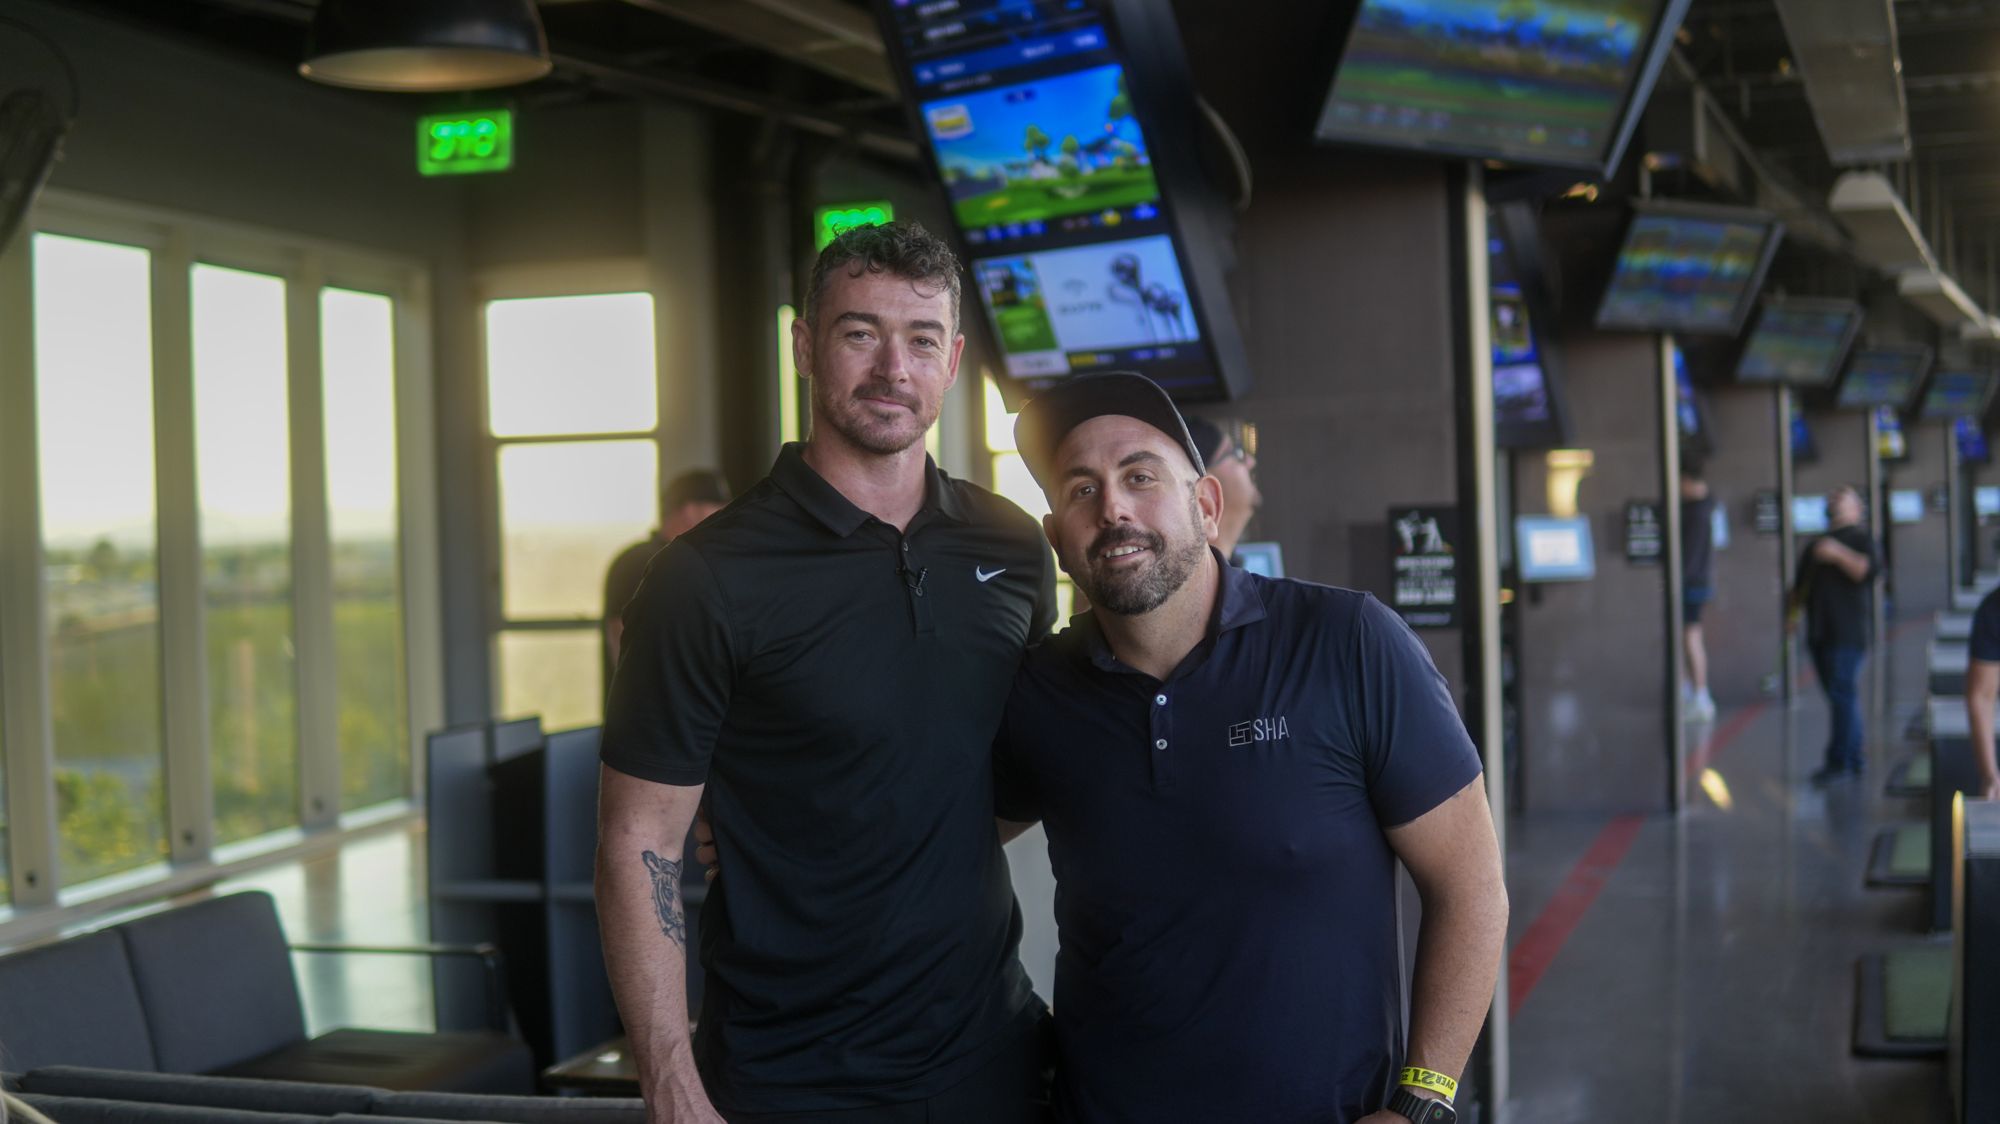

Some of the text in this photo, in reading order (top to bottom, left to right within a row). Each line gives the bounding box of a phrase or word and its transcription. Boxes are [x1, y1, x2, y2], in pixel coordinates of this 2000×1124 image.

[1253, 715, 1290, 741] SHA
[1412, 1068, 1435, 1086] 21
[1435, 1073, 1455, 1090] OVER
